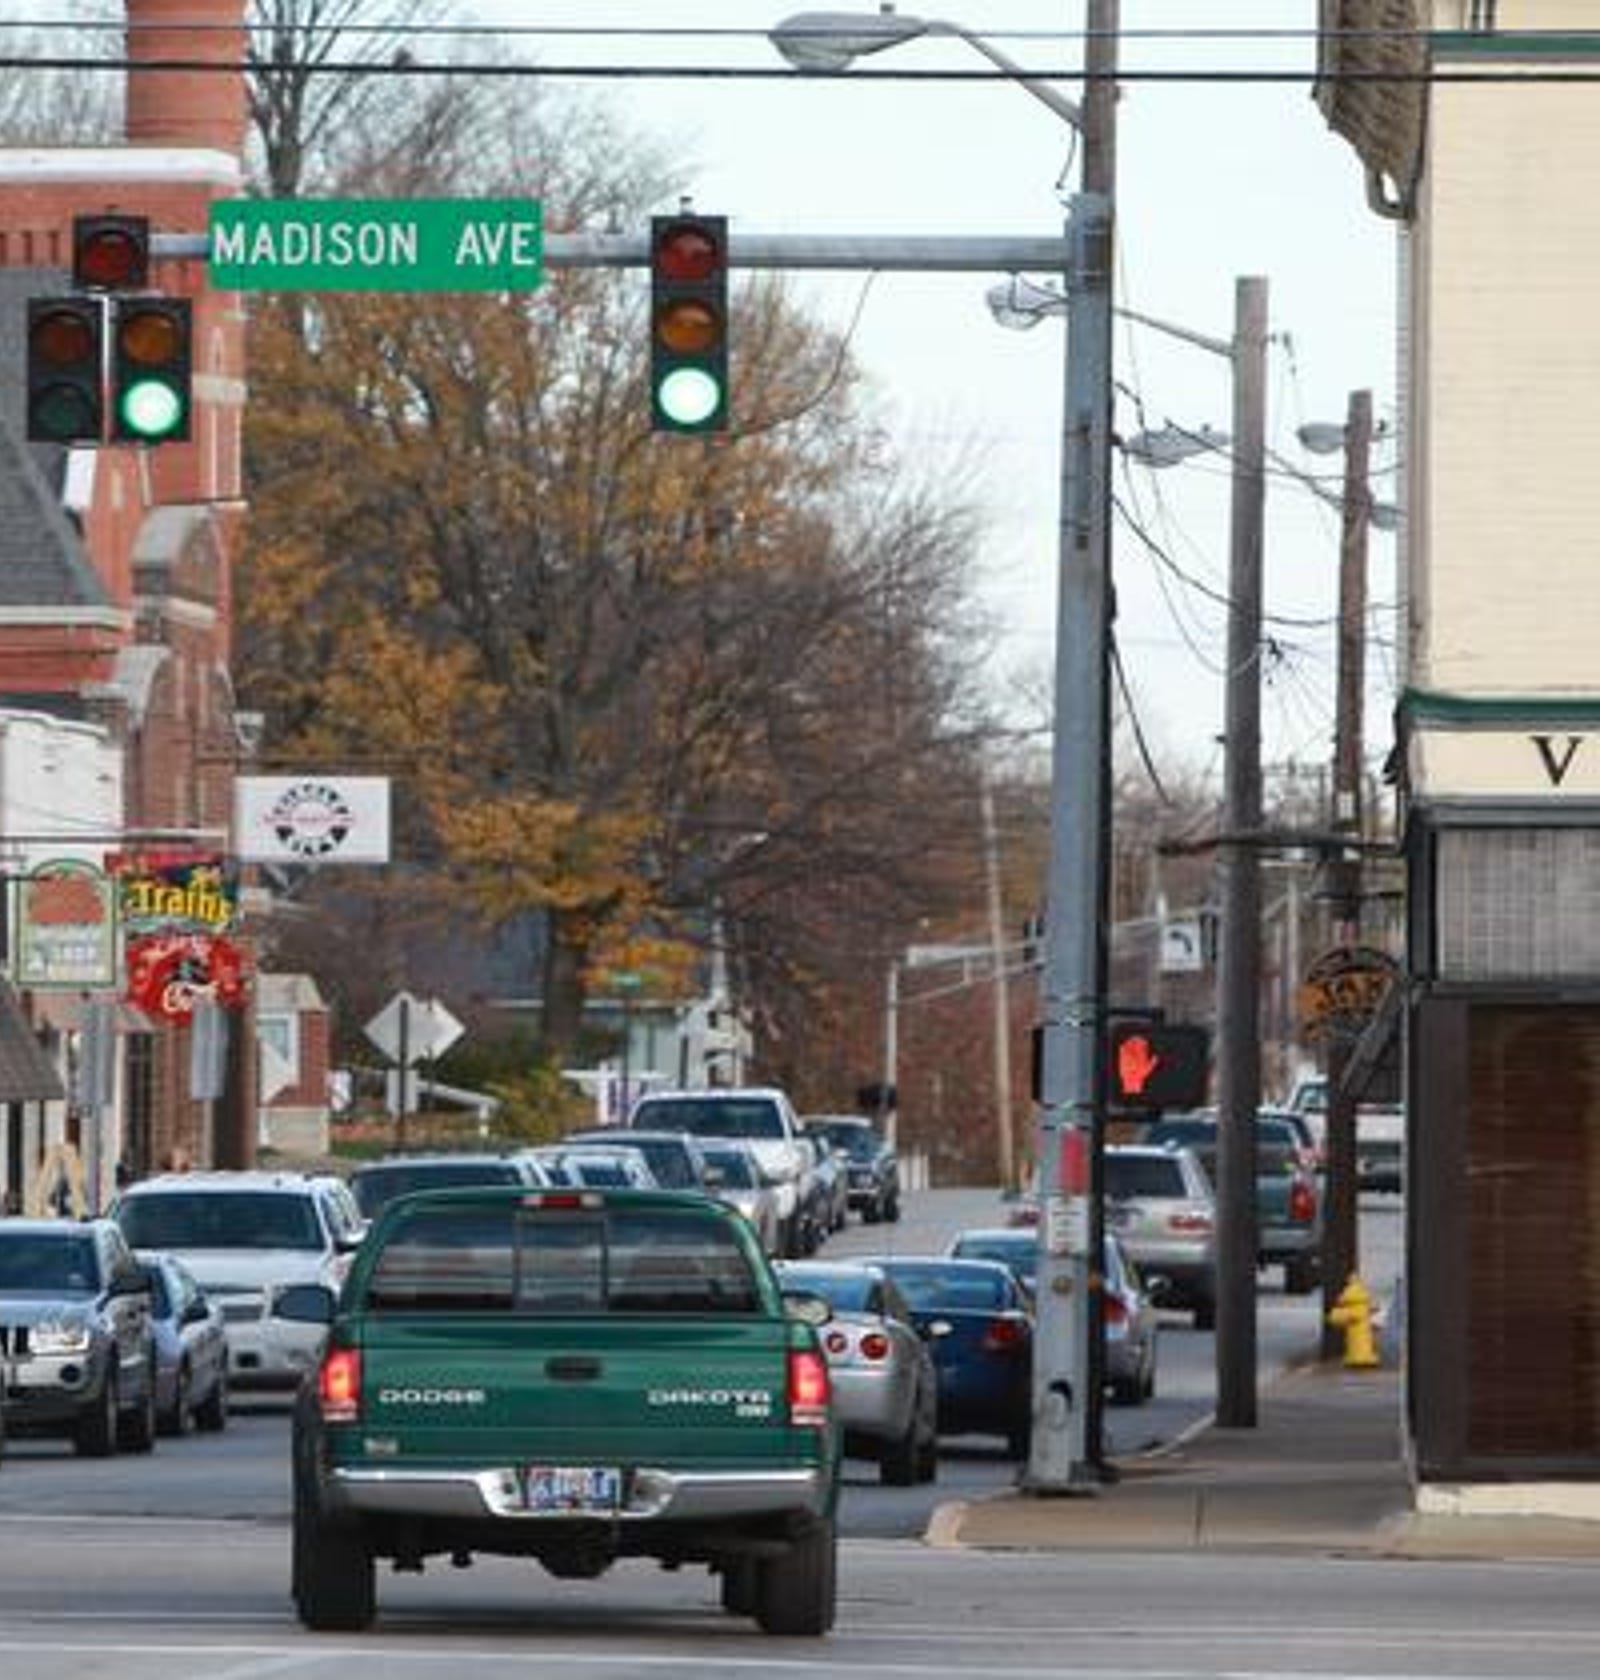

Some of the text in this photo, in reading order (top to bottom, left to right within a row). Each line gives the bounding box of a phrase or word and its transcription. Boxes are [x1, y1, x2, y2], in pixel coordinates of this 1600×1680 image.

[213, 222, 537, 266] MADISON AVE
[1529, 735, 1584, 787] V
[378, 1388, 486, 1404] DODGE
[647, 1388, 771, 1406] DAKOTA
